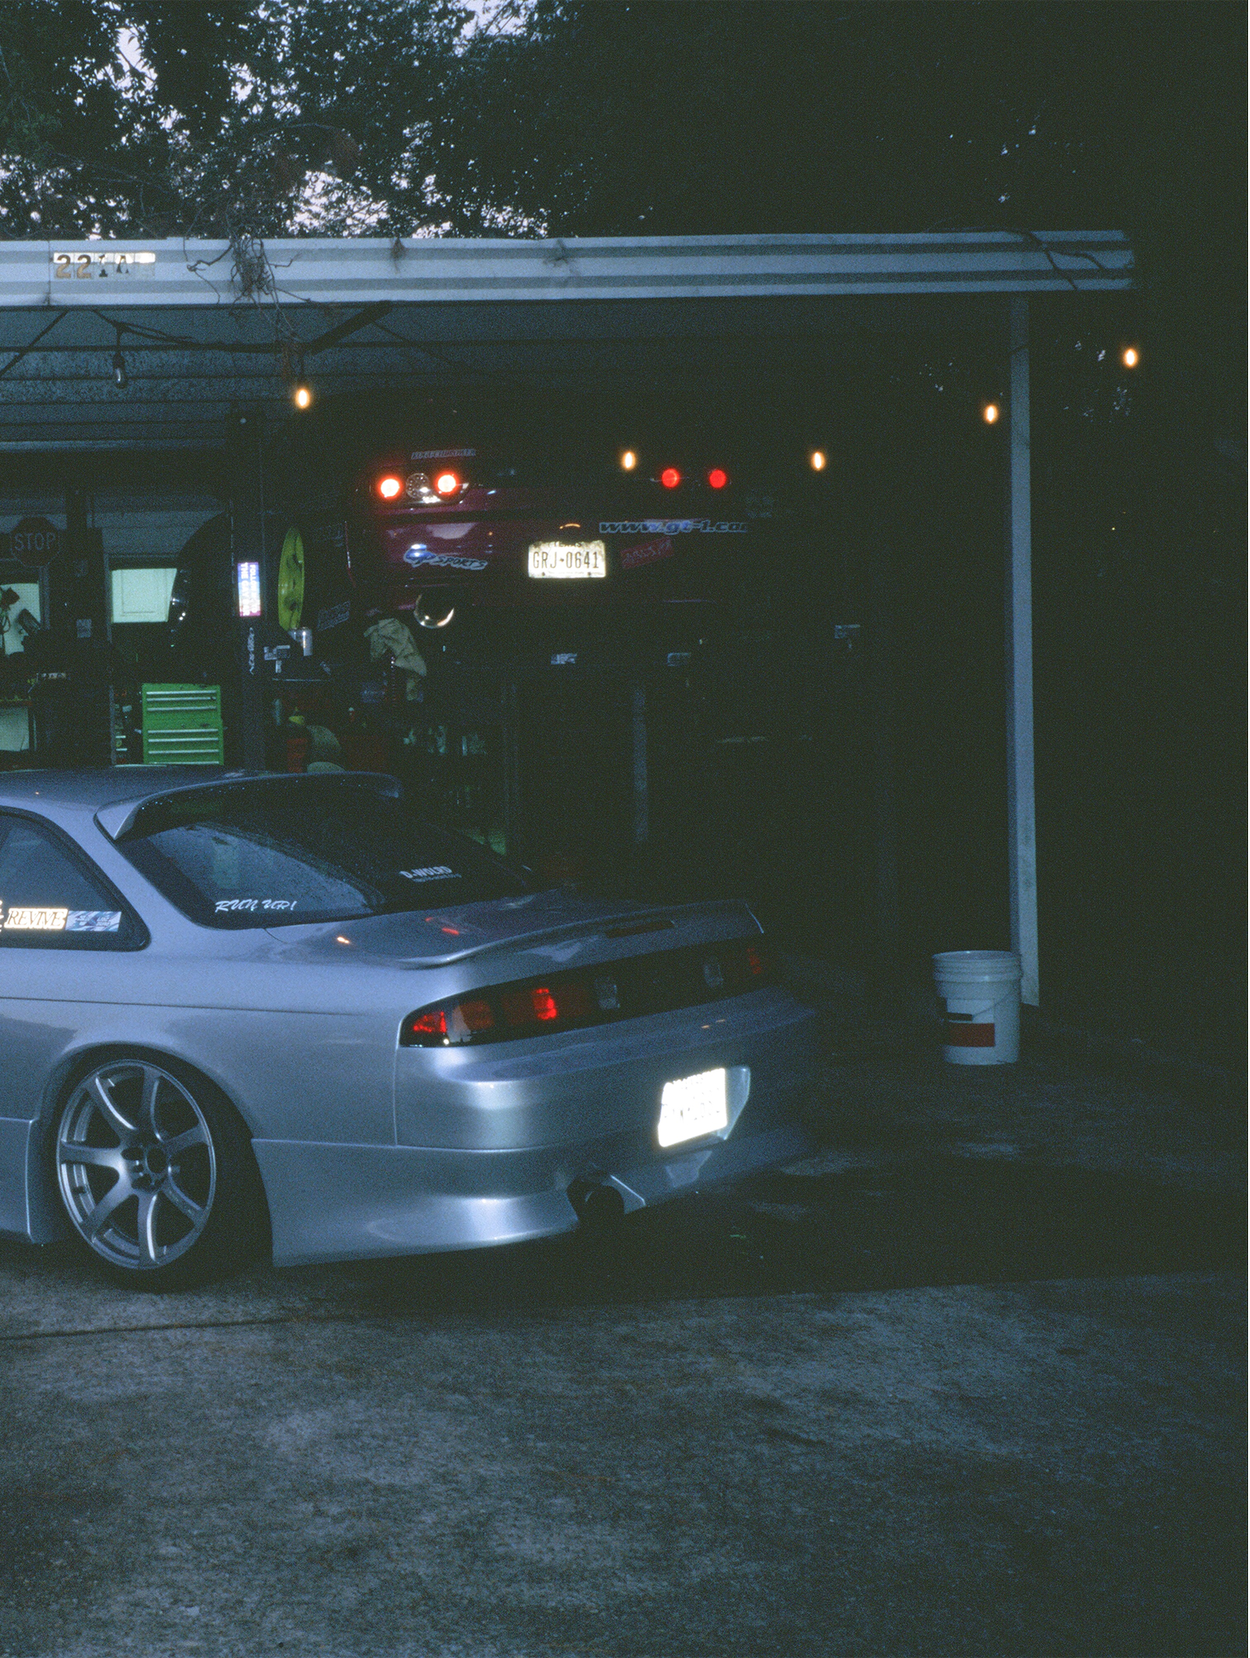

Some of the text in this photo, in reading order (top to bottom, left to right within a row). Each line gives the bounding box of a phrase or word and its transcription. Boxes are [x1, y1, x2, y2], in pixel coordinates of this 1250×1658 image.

[14, 532, 56, 551] STOP
[214, 898, 259, 913] RUN
[6, 909, 66, 927] REVIVE
